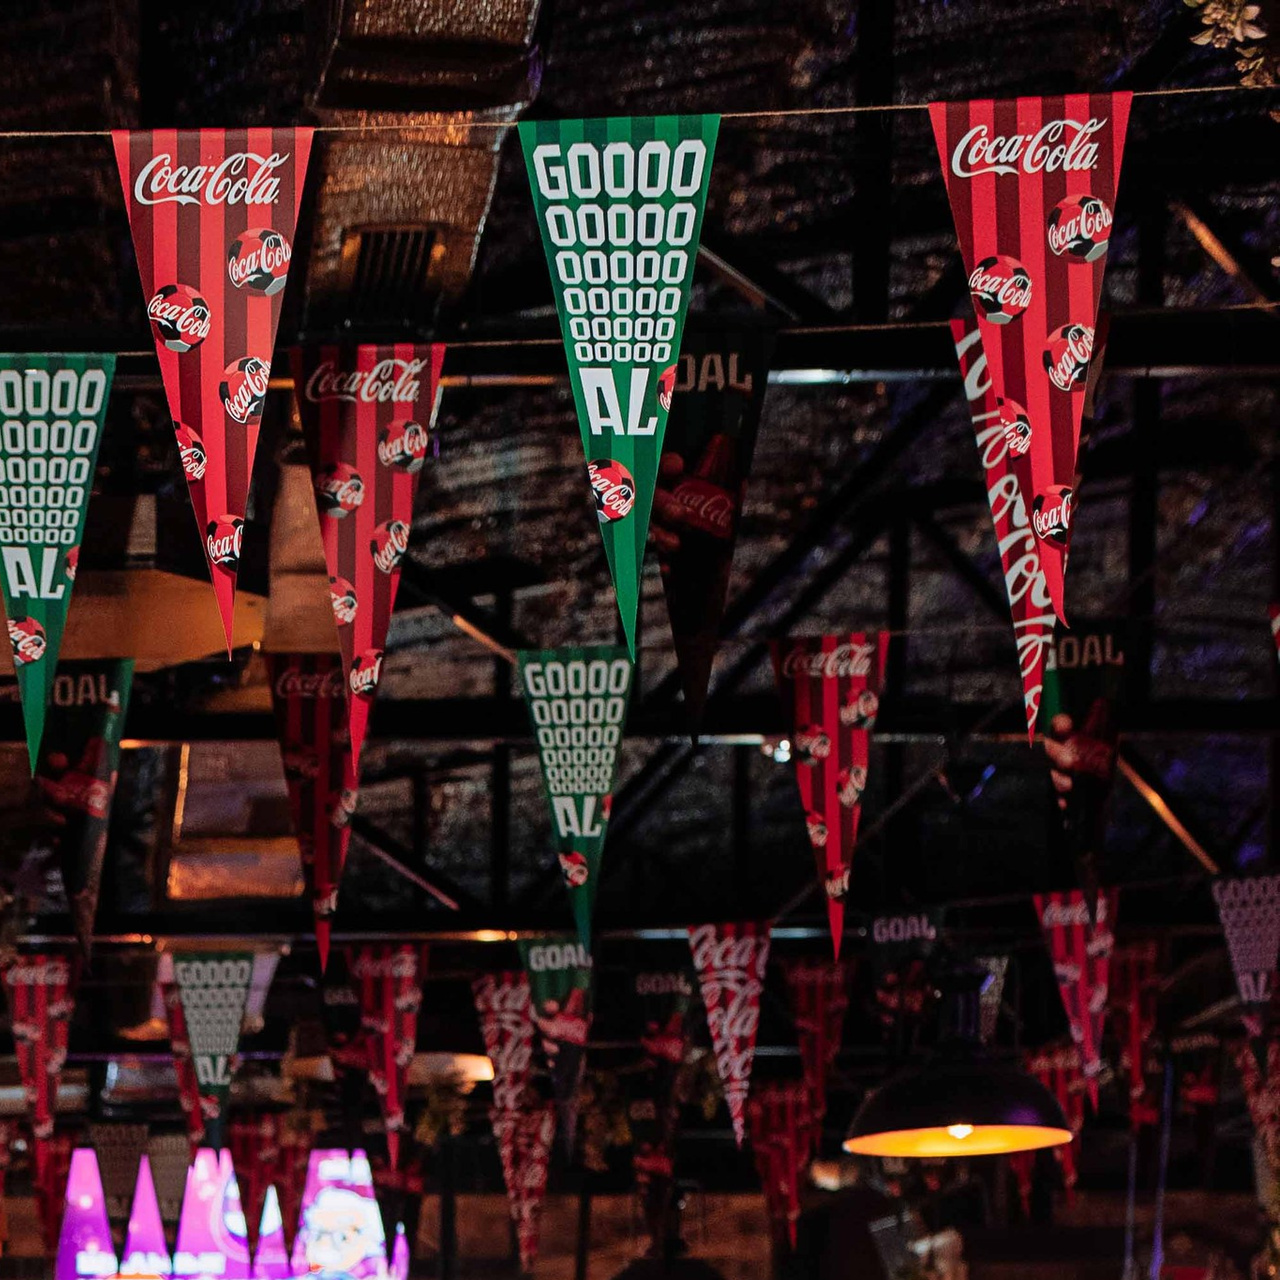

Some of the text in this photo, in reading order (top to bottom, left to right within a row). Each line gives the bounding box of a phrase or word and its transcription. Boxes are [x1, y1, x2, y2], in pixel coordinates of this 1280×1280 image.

[951, 118, 1108, 178] Coca-Cola
[134, 152, 290, 207] Coca-Cola
[532, 139, 707, 200] GOOOO
[545, 202, 697, 247] OOOOO
[555, 249, 689, 285] OOOOO
[968, 267, 1032, 308] Coca-Cola
[147, 293, 211, 339] Coca-Cola
[563, 287, 682, 316] OOOOO
[569, 317, 676, 341] OOOOO
[574, 341, 672, 362] OOOOO
[305, 358, 427, 403] Coca-Cola
[578, 367, 659, 436] AL
[0, 546, 66, 600] AL
[524, 658, 631, 697] GOOOO
[531, 697, 625, 726] OOOOO
[537, 725, 620, 749] OOOOO
[552, 795, 603, 838] AL
[873, 914, 938, 945] GOAL
[528, 942, 593, 972] GOAL
